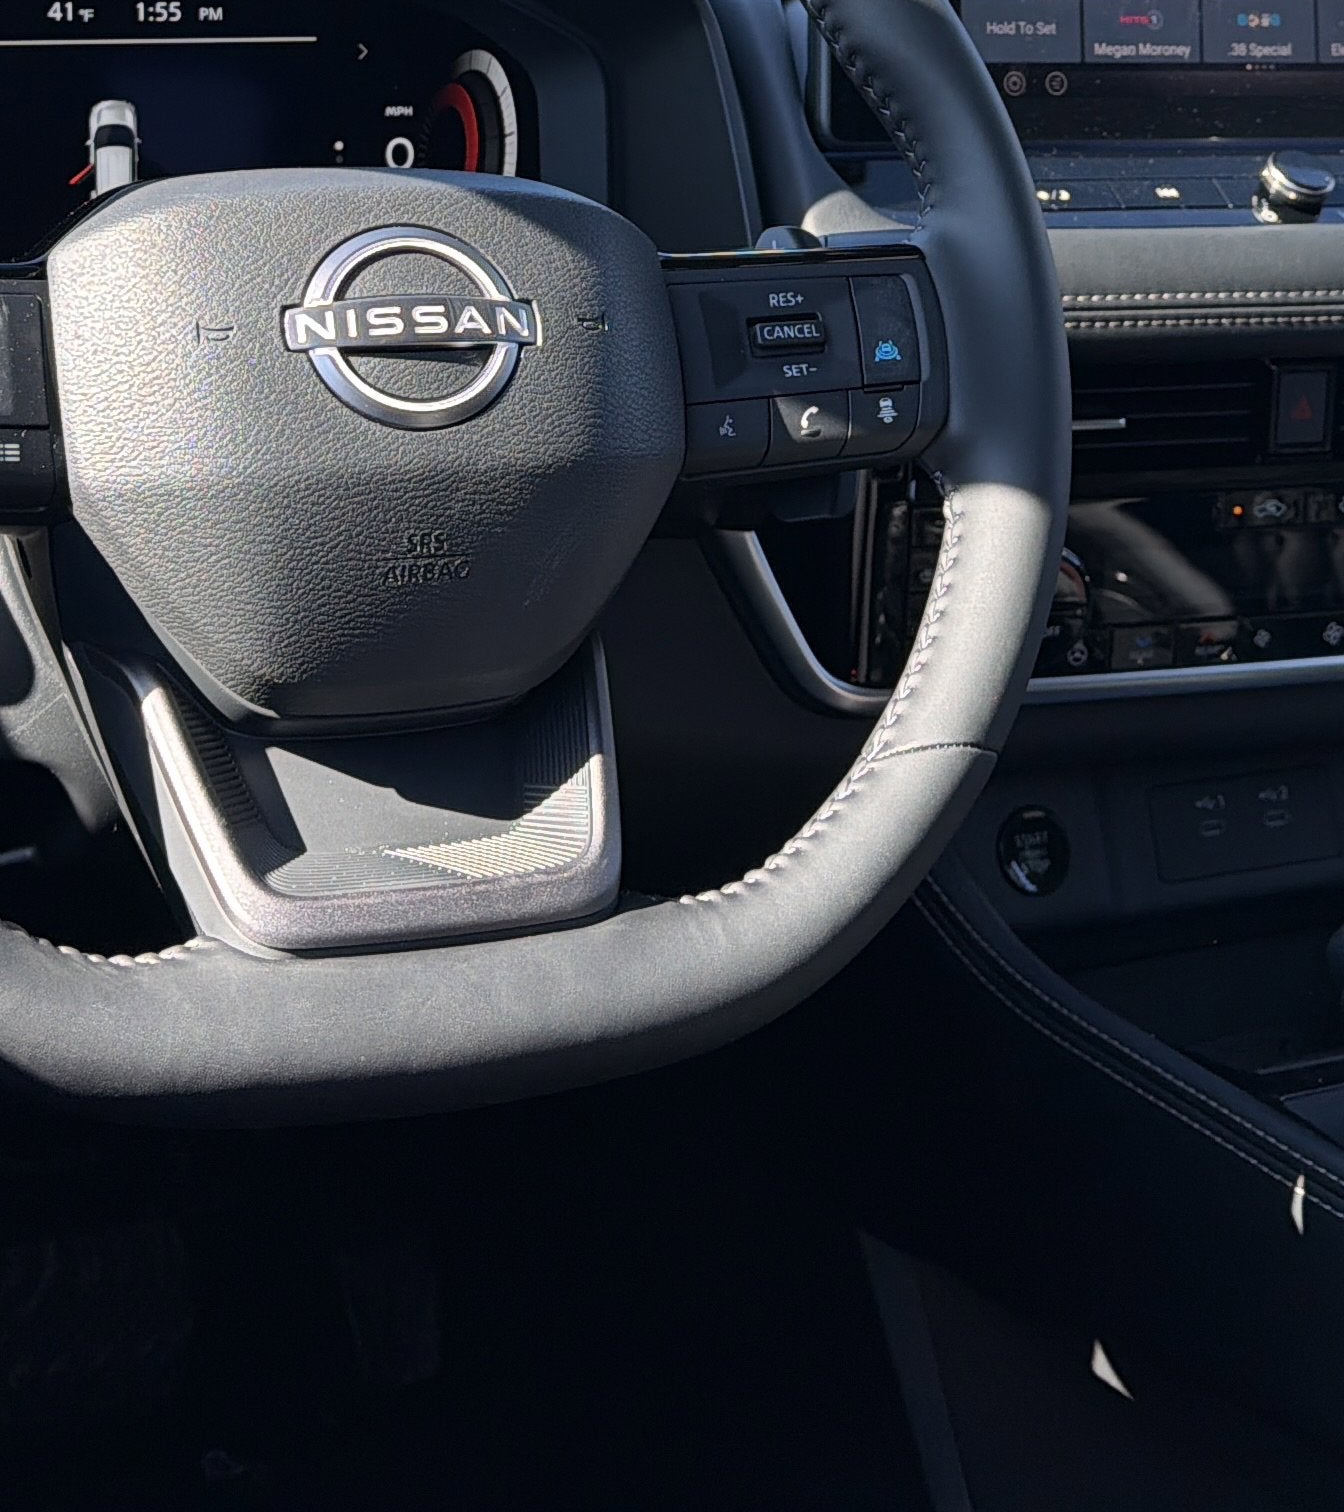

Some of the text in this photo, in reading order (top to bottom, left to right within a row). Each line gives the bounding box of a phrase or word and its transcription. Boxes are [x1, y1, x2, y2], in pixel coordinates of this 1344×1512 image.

[136, 1, 182, 22] 1:55
[198, 6, 223, 21] PM
[986, 21, 1057, 36] Hold To Set
[1094, 43, 1135, 59] Megan
[385, 105, 414, 117] MPH
[769, 292, 805, 308] RES+
[294, 304, 530, 344] NISSAN
[763, 324, 821, 340] CANCEL
[783, 364, 818, 378] SET-
[405, 531, 449, 555] SRS
[381, 561, 471, 588] AIRBAG
